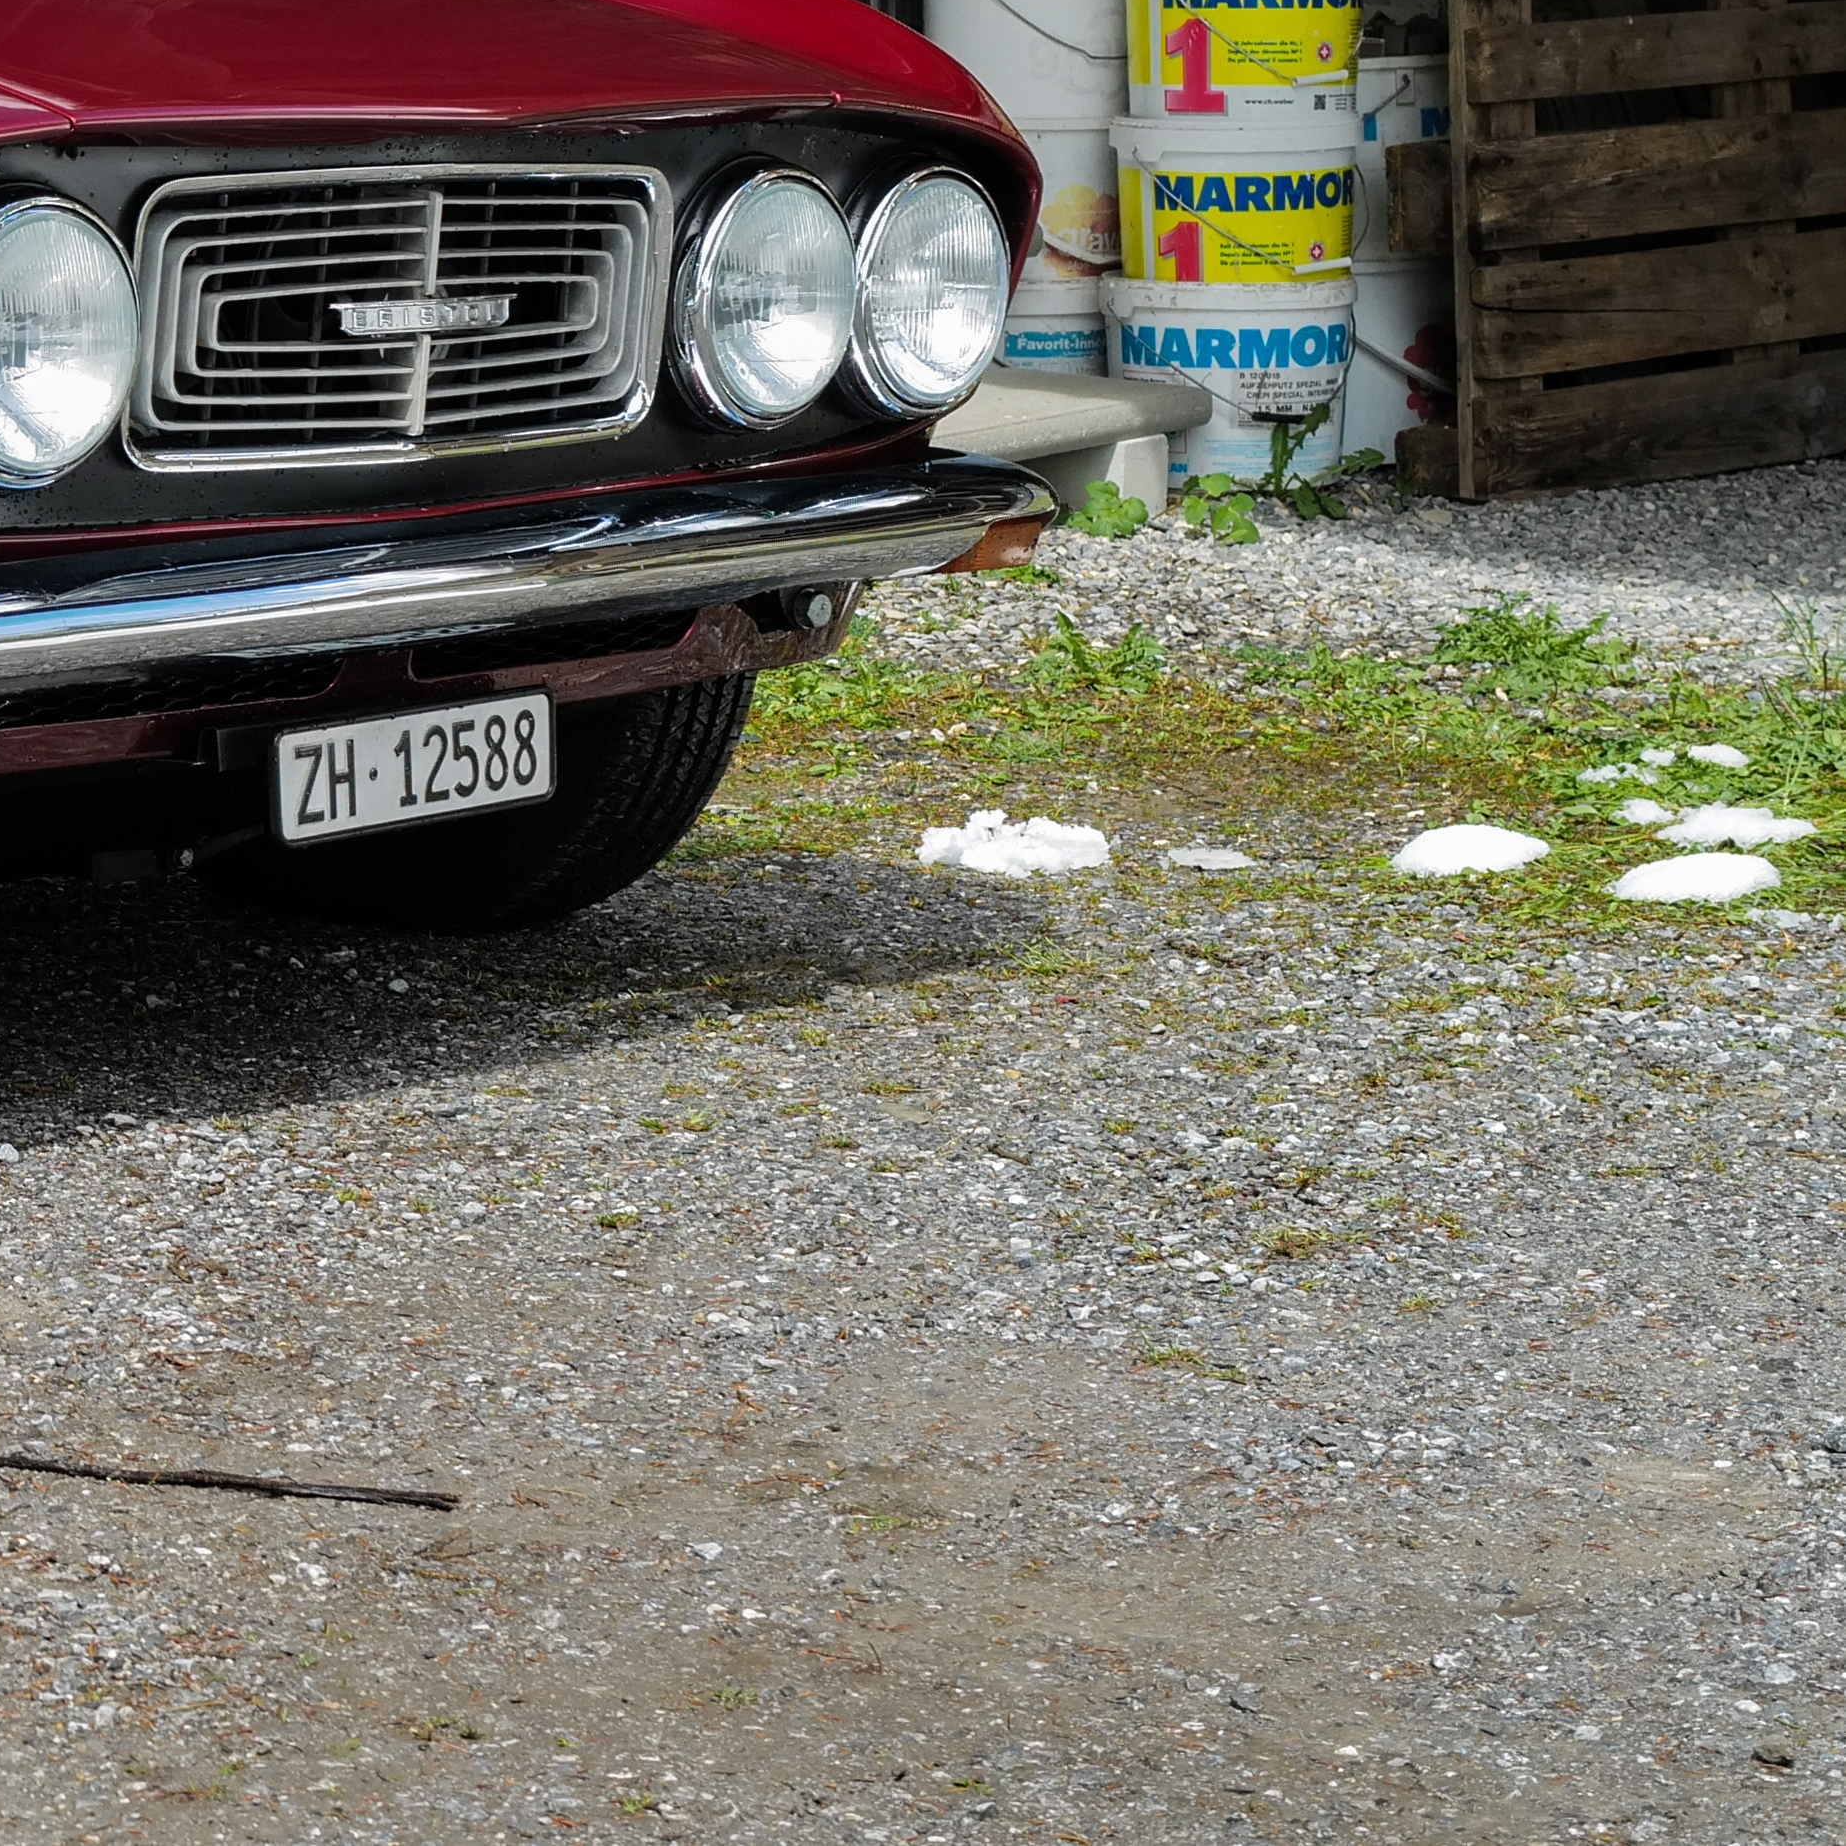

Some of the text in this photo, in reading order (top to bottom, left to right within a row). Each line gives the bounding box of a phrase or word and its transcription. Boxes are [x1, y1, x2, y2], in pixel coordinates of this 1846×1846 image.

[1165, 18, 1226, 114] 1
[1153, 169, 1354, 212] MARMOR
[352, 302, 502, 329] BRISTOL
[1121, 323, 1348, 368] MARMOR
[1273, 390, 1304, 399] SPECIAL
[1276, 405, 1293, 413] MM
[294, 709, 538, 825] ZH 12588
